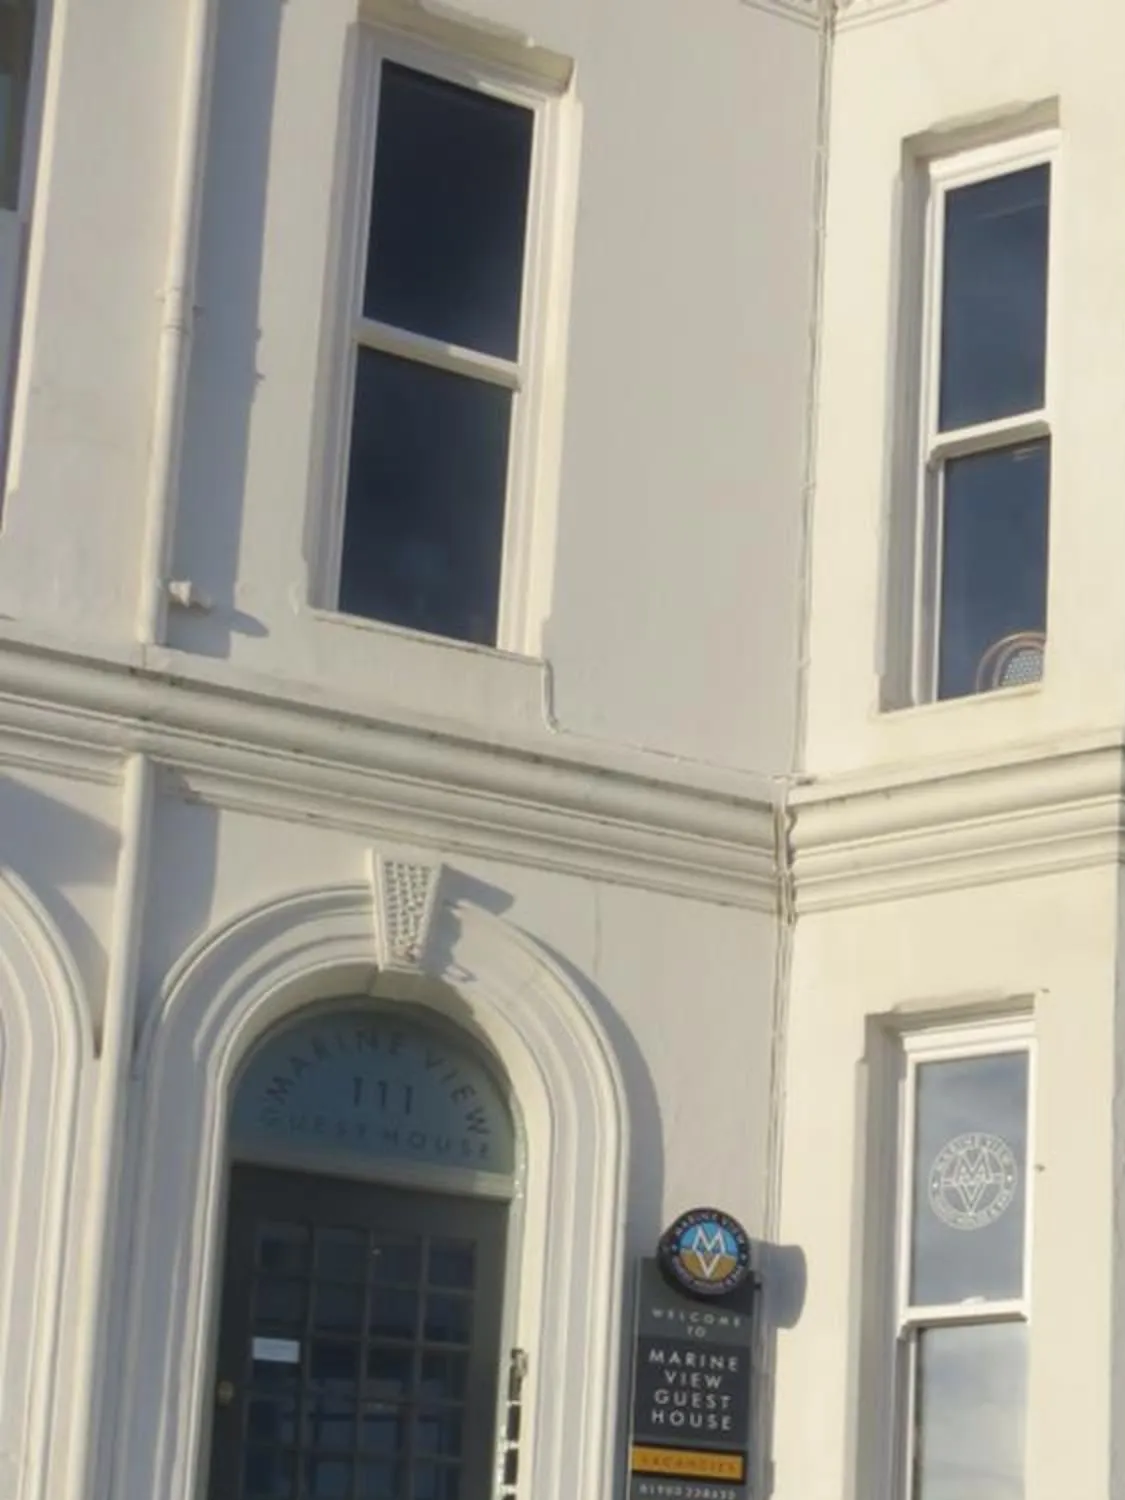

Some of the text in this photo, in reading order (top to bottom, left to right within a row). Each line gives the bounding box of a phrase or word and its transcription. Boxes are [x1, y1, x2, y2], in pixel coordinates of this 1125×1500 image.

[264, 1026, 491, 1136] MARINE VIEW
[649, 1348, 739, 1373] MARINE
[664, 1369, 723, 1389] VIEW
[654, 1388, 732, 1410] GUEST
[651, 1408, 732, 1431] HOUSE
